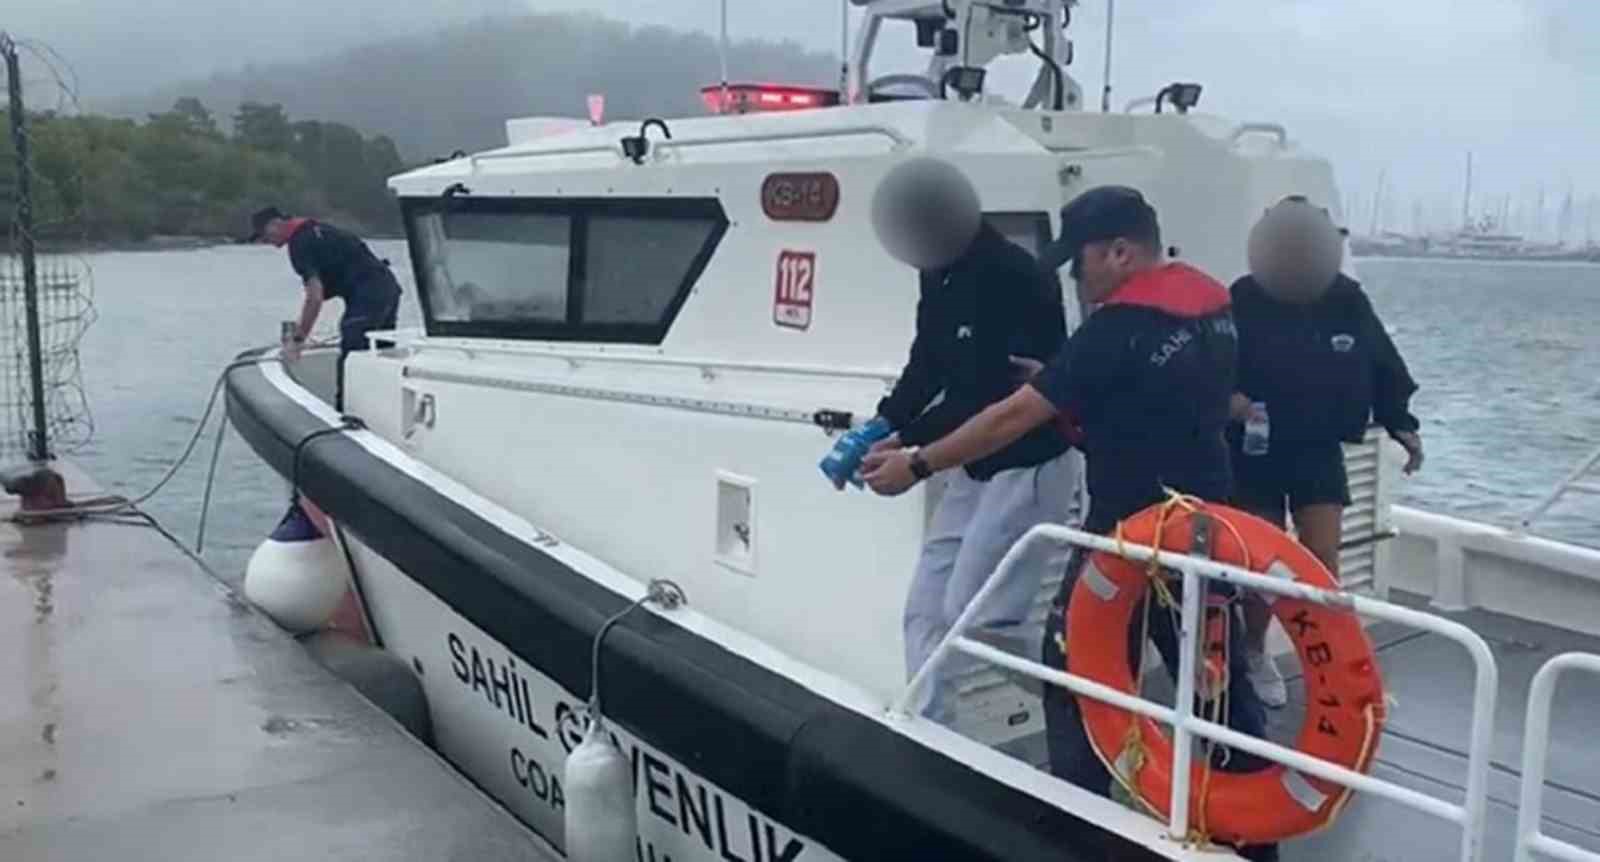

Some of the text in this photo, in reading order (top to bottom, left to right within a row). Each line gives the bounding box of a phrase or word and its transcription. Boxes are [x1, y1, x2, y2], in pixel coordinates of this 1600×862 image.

[780, 256, 811, 302] 112
[447, 632, 548, 739] SAHİL
[1290, 610, 1340, 737] KB-14
[511, 747, 565, 814] COA
